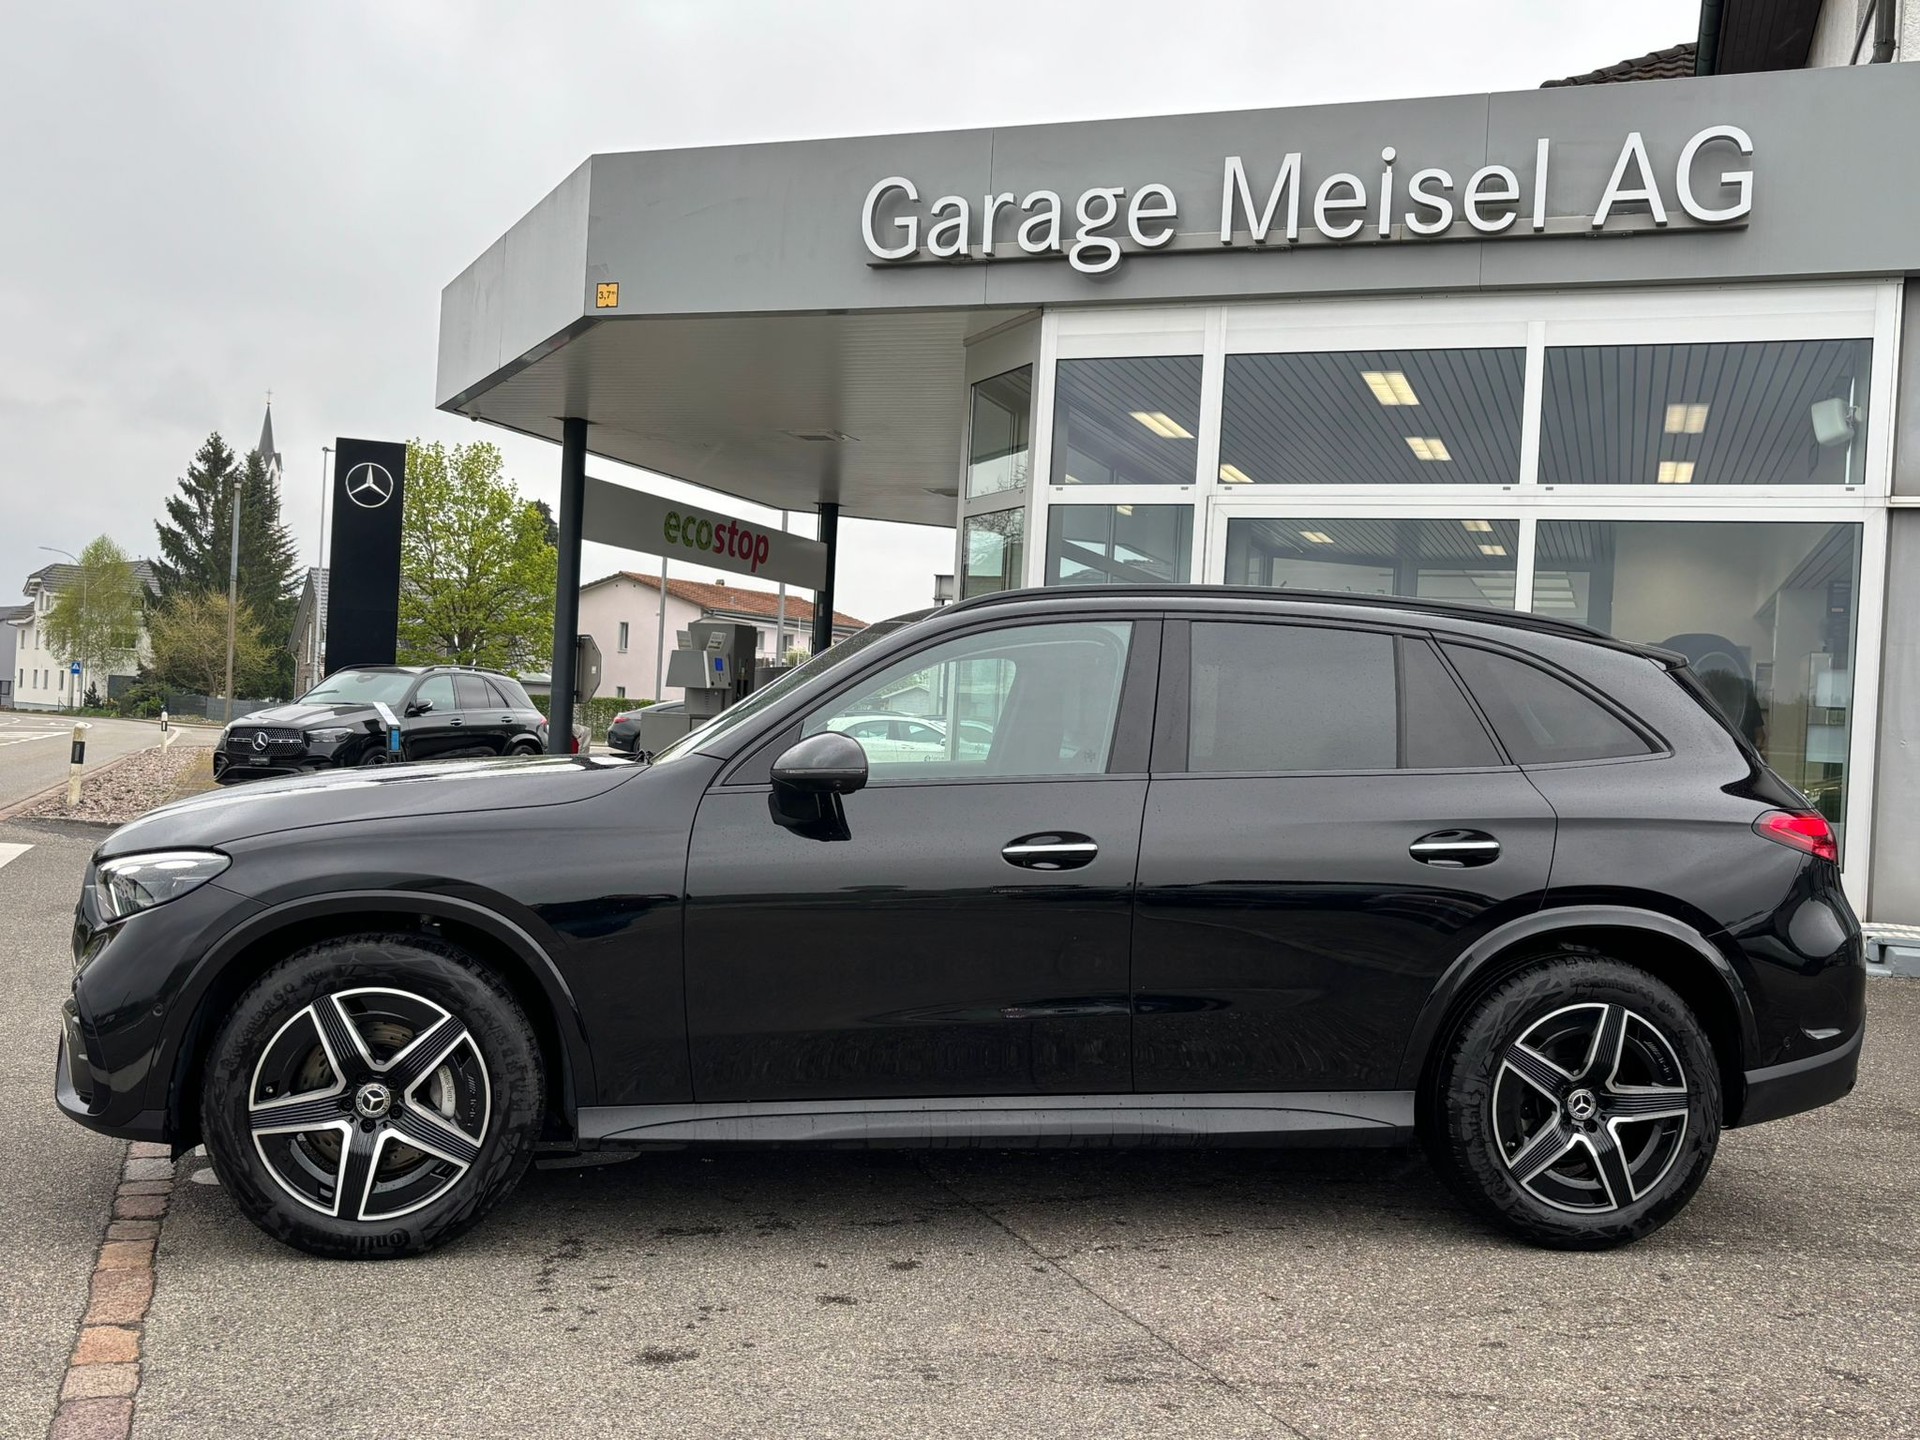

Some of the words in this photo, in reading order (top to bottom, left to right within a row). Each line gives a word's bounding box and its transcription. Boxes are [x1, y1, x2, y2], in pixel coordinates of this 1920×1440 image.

[861, 176, 1178, 273] Garage
[1220, 137, 1550, 244] Meisel
[1591, 125, 1754, 230] AG
[663, 511, 769, 573] ecostop
